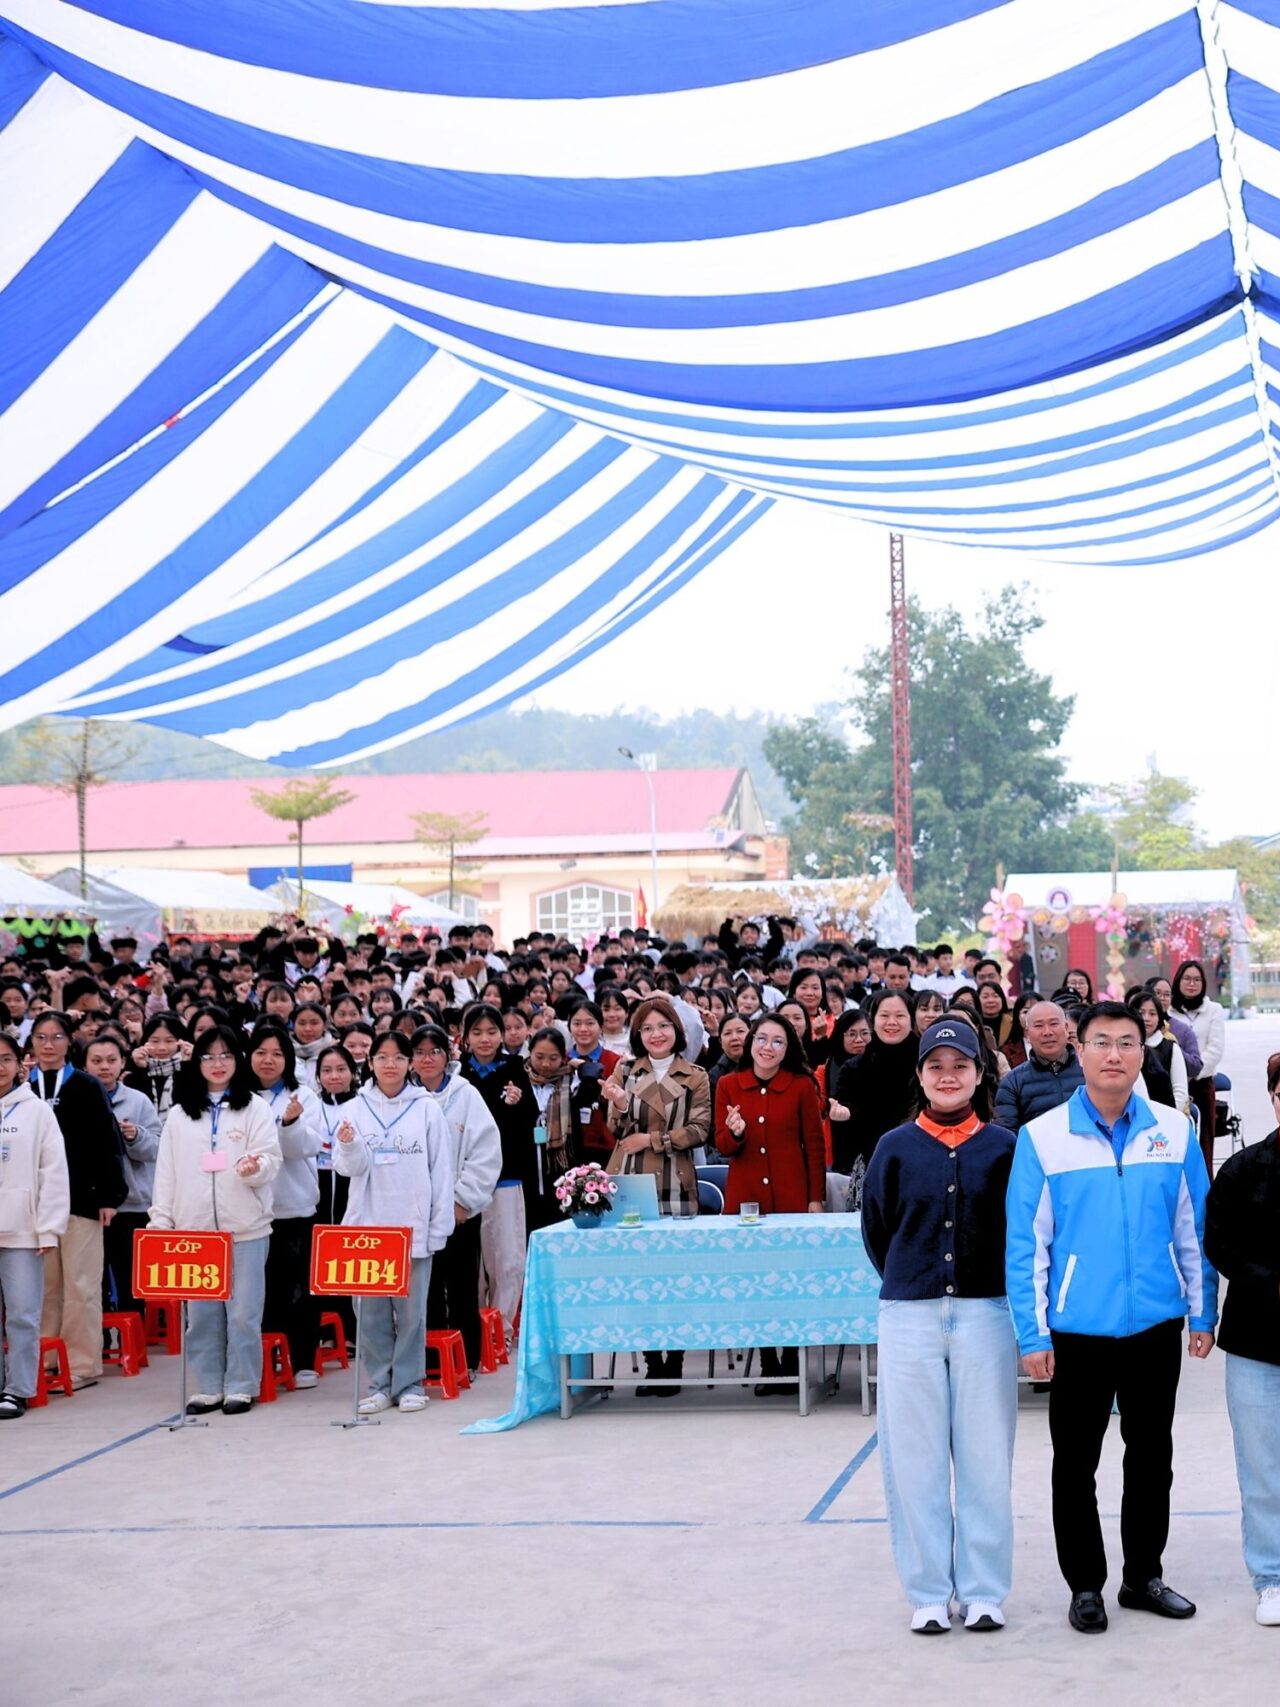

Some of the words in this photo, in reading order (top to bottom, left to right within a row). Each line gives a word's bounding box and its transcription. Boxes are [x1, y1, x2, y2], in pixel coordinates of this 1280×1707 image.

[163, 1239, 203, 1254] LỚP
[342, 1234, 382, 1250] LỚP
[146, 1263, 220, 1290] 11B3
[324, 1258, 399, 1286] 11B4
